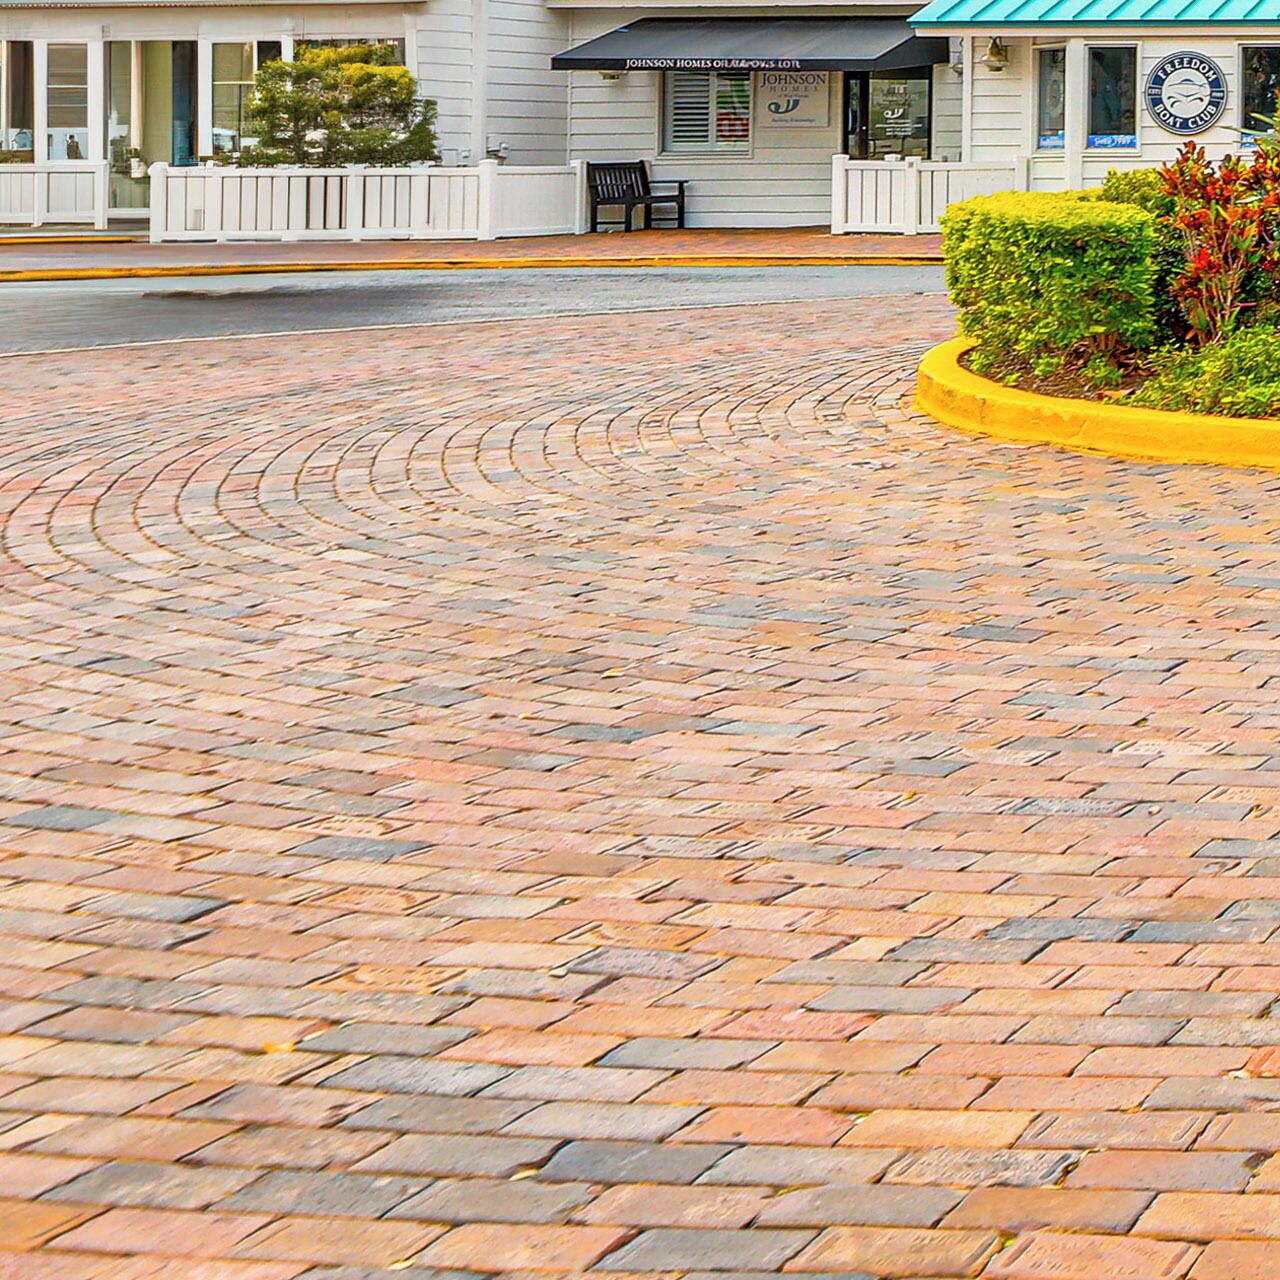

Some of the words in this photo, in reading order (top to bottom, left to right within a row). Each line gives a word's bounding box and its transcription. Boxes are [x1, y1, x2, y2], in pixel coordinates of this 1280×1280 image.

[625, 59, 674, 69] JOHNSON
[676, 59, 712, 68] HOMES
[1157, 57, 1217, 81] FREEDOM
[760, 73, 826, 88] JOHNSON
[1154, 104, 1183, 128] BOAT
[1187, 104, 1217, 128] CLUB
